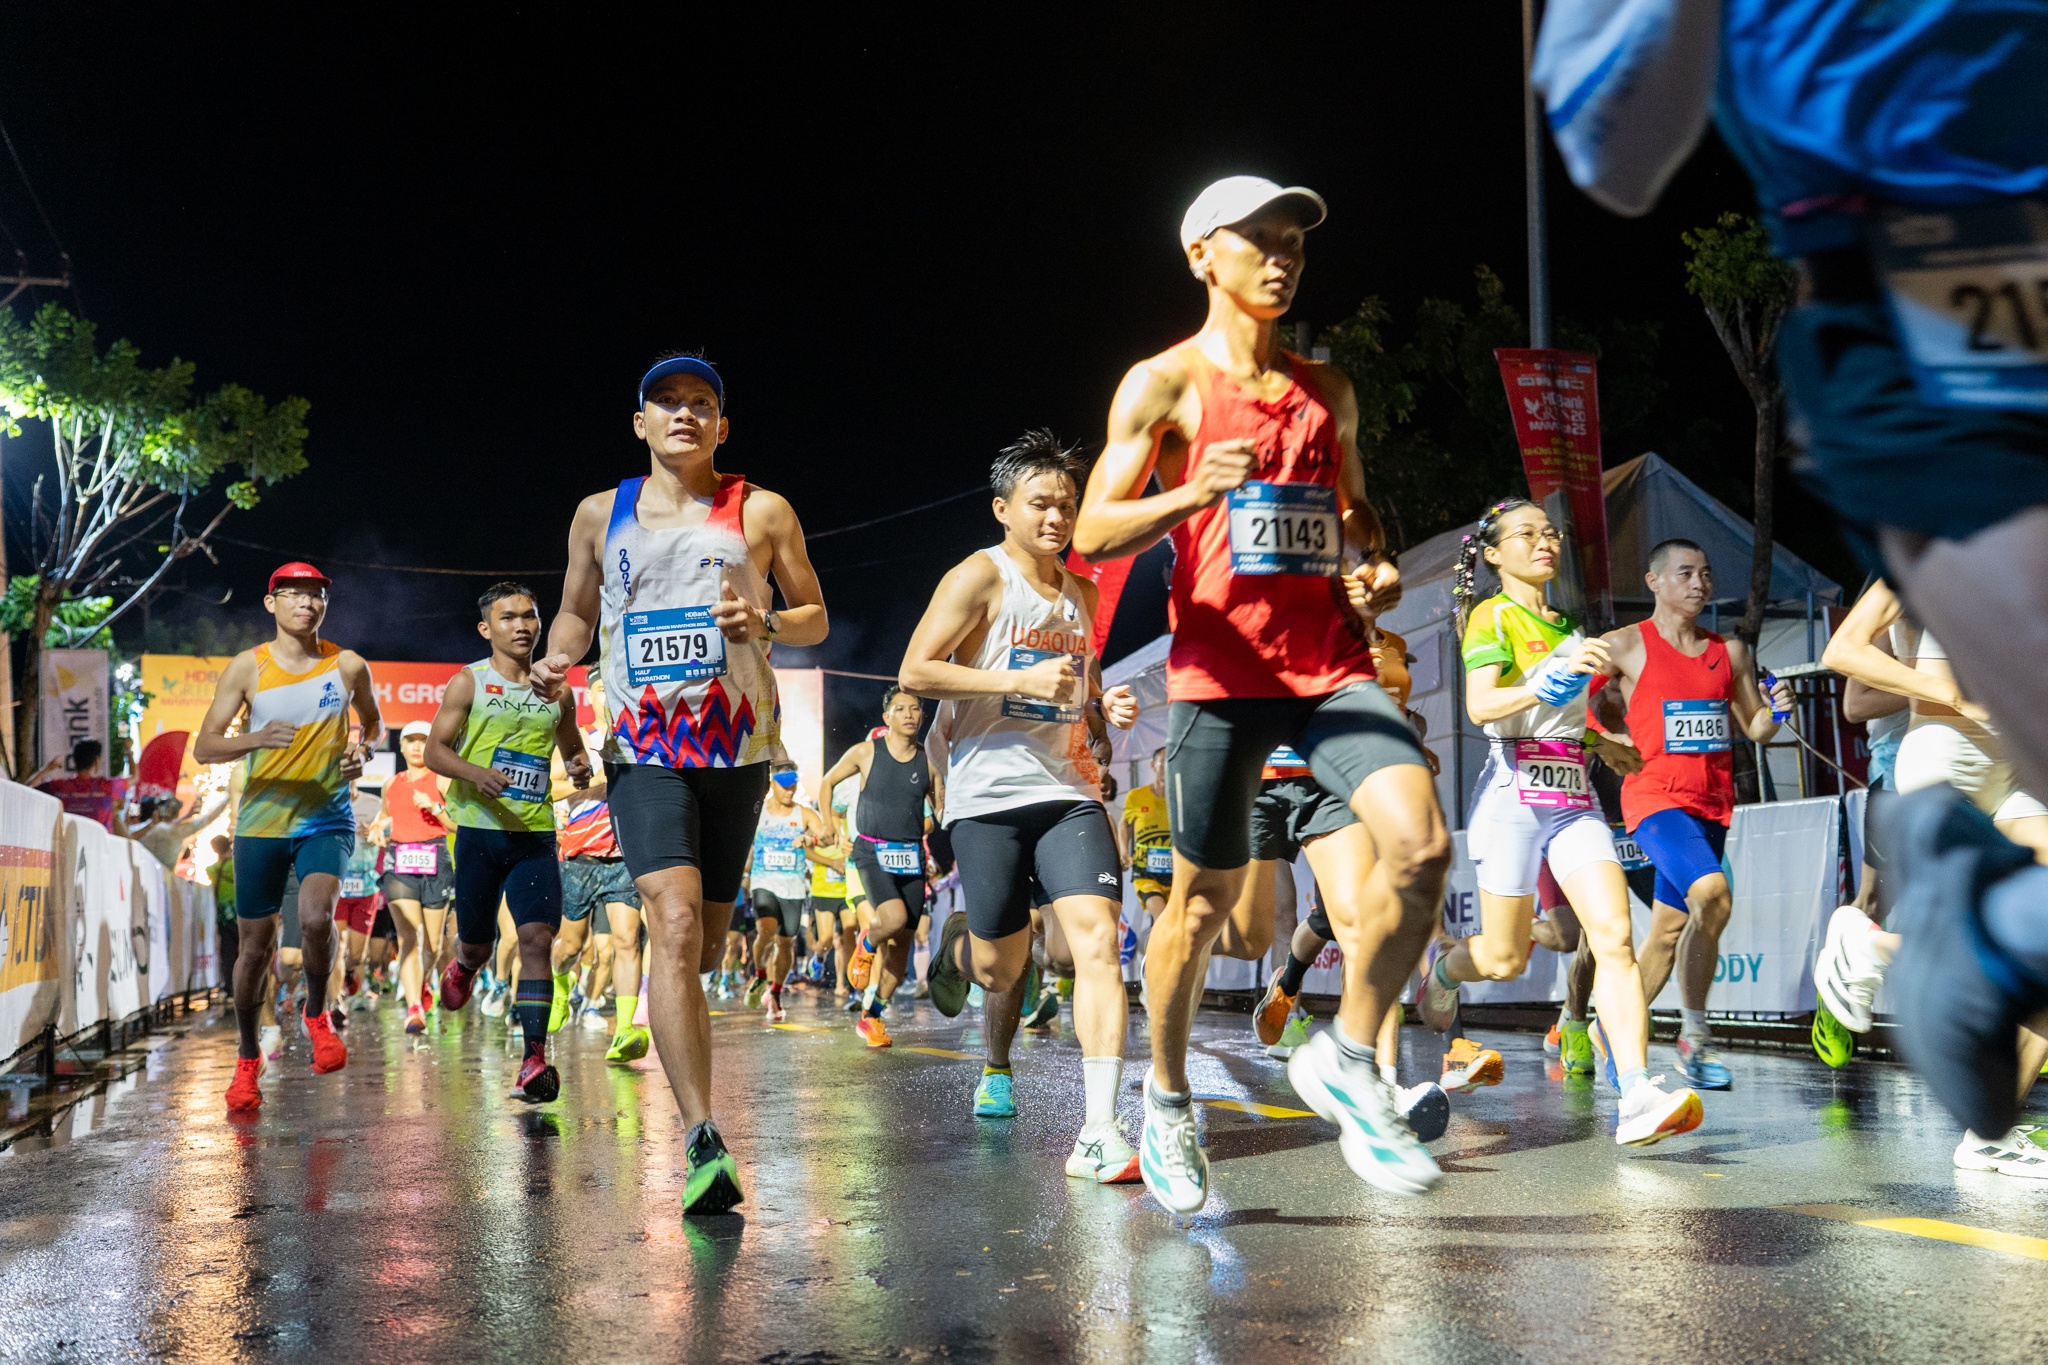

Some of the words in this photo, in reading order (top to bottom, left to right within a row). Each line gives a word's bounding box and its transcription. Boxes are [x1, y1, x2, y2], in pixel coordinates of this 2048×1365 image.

[1251, 516, 1326, 550] 21143
[641, 633, 708, 663] 21579
[635, 674, 671, 683] MARATHON
[487, 697, 551, 714] ANTA
[1008, 710, 1044, 719] MARATHON
[1675, 719, 1724, 738] 21486
[1529, 764, 1582, 790] 20278
[402, 855, 430, 865] 20155
[884, 854, 911, 866] 21116
